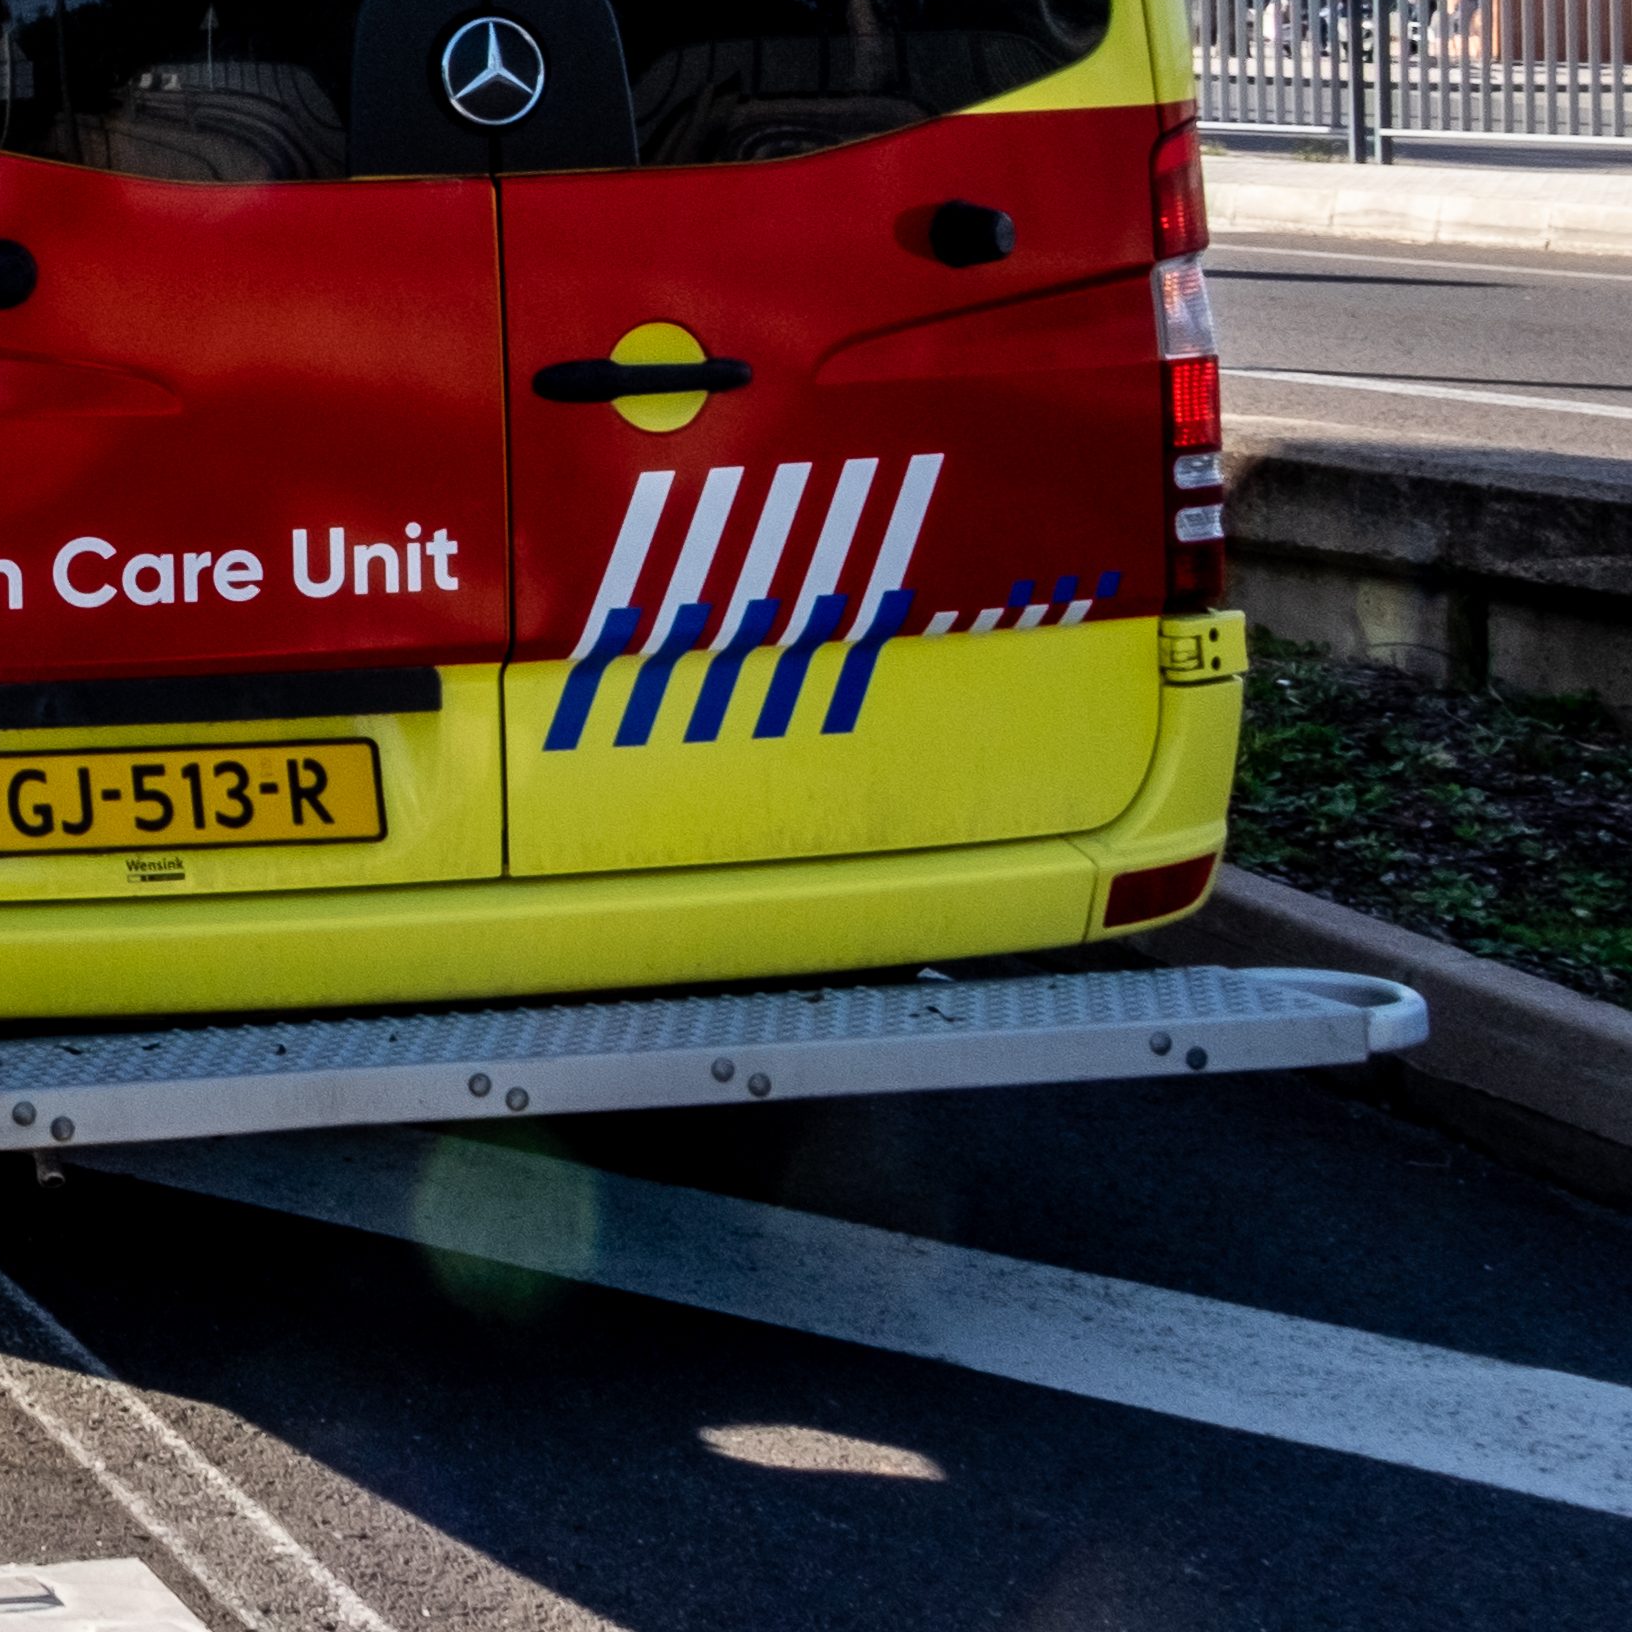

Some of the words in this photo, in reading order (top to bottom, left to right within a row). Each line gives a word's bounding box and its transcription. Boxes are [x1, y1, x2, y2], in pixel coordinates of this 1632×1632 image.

[53, 537, 264, 609] Care
[293, 521, 459, 598] Unit
[7, 758, 337, 838] GJ-513-R
[126, 857, 184, 872] Wensink
